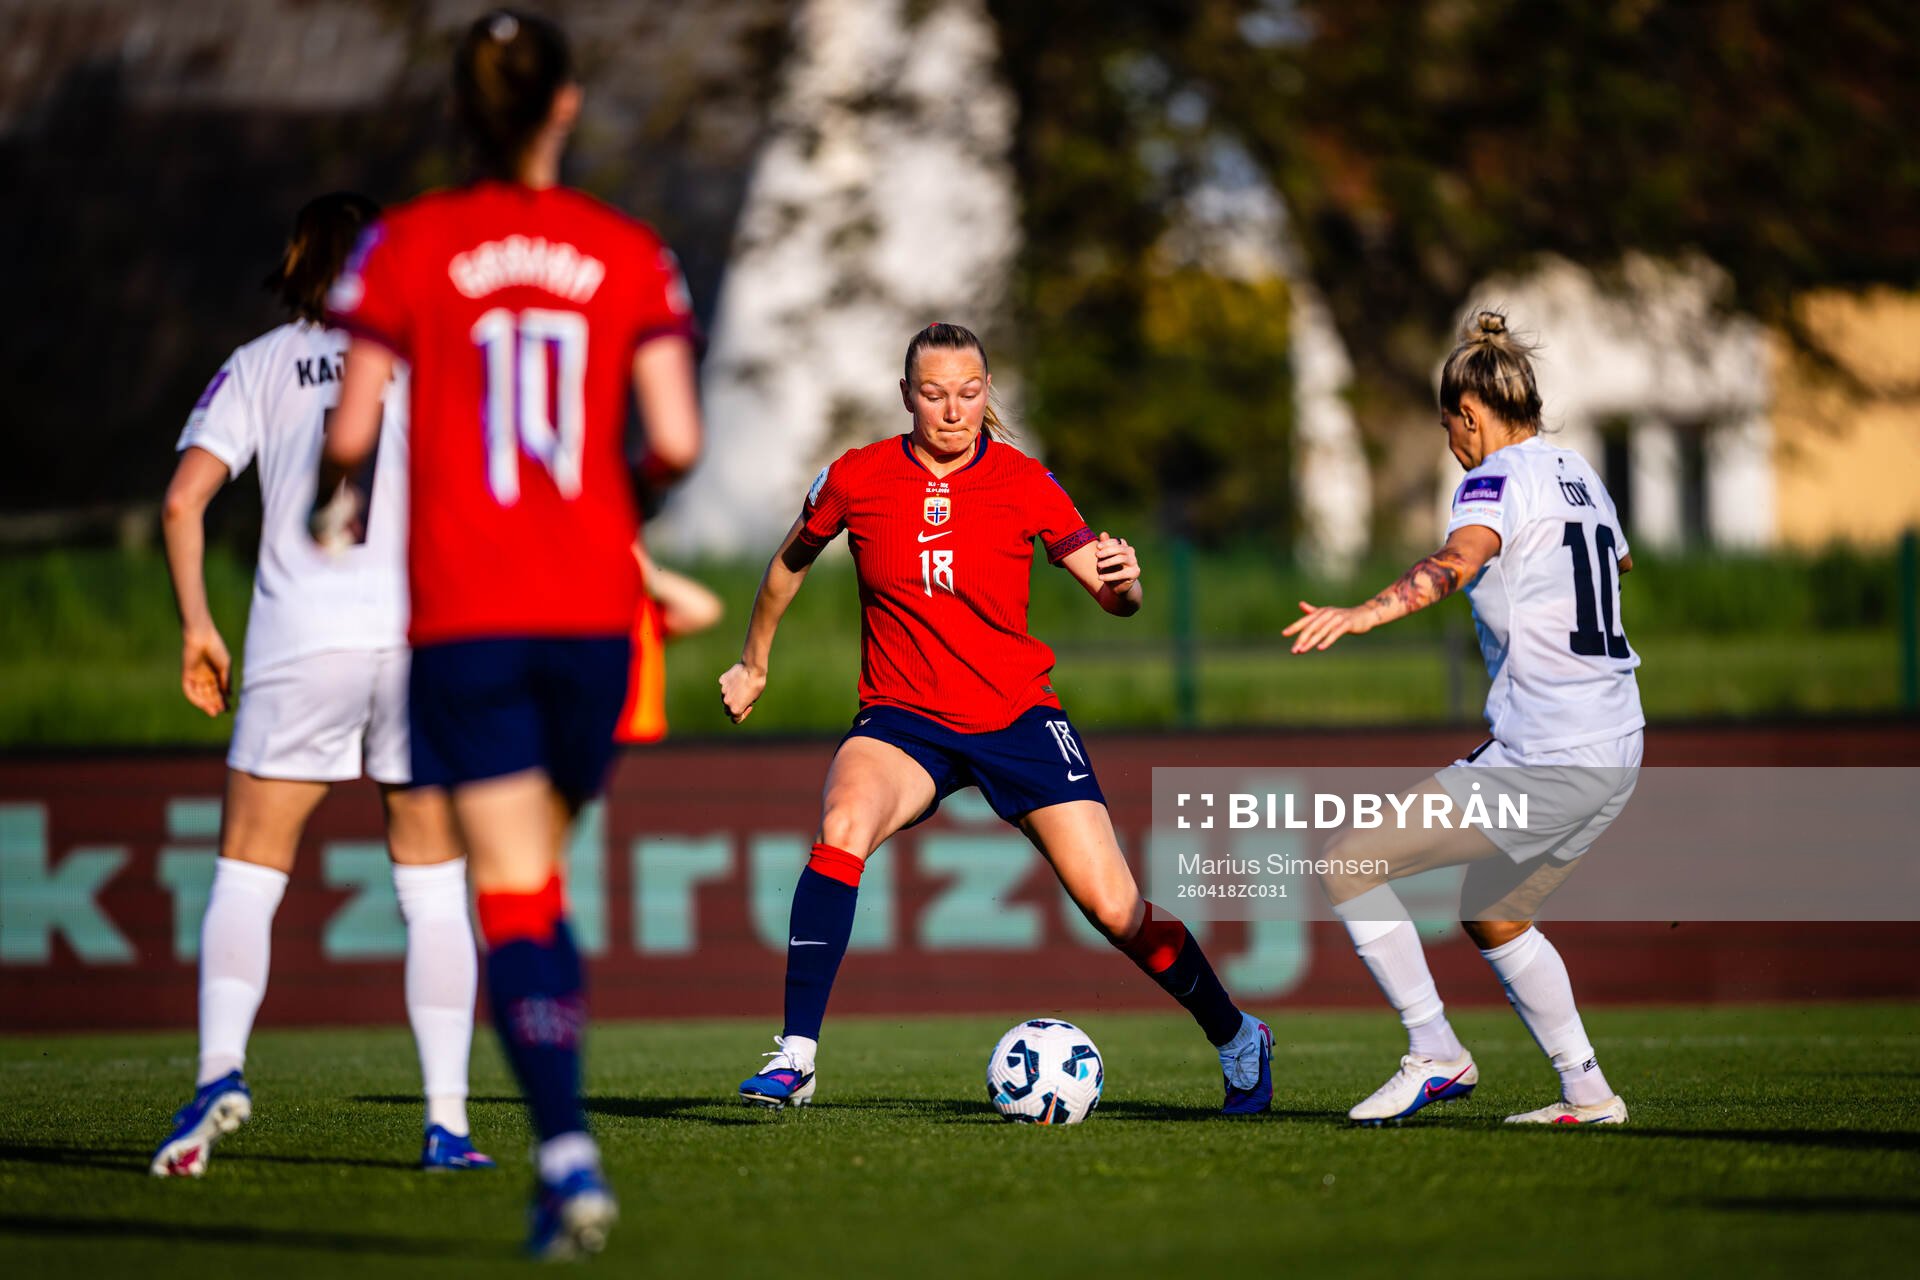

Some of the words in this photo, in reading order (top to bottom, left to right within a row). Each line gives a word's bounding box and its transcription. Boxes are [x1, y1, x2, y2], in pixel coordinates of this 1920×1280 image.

[470, 307, 589, 506] 10
[919, 550, 954, 598] 18
[1562, 522, 1631, 658] 10
[1045, 720, 1086, 767] 18
